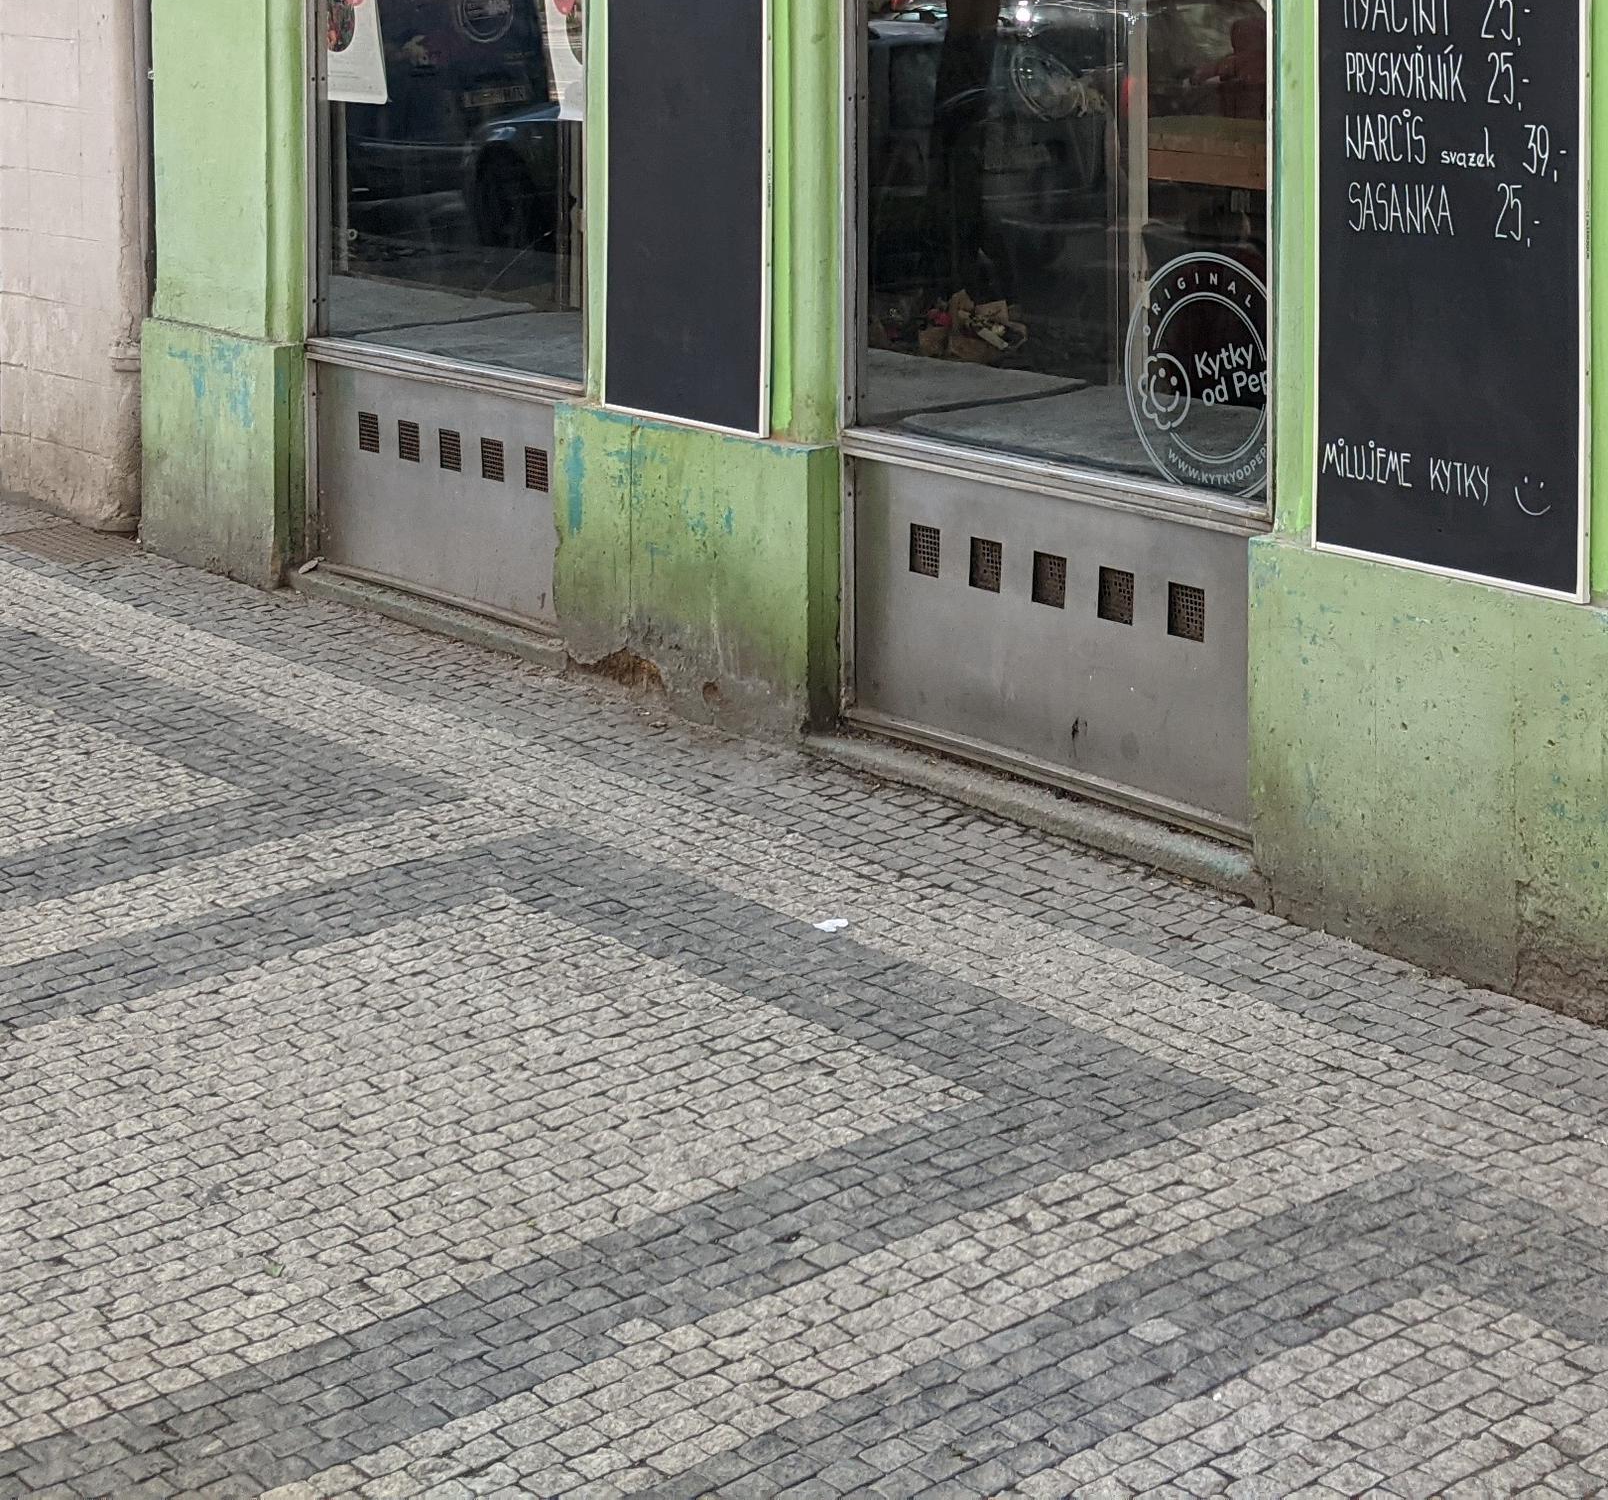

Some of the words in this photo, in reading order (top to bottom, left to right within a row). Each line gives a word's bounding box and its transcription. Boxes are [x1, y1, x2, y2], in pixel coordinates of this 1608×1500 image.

[1440, 126, 1496, 169] svazek
[1348, 181, 1456, 237] SASANKA
[1142, 271, 1253, 337] ORIGINAL
[1194, 342, 1254, 379] Kytky
[1202, 375, 1229, 408] od
[1232, 368, 1267, 398] Pep
[1429, 457, 1490, 506] KYTKY
